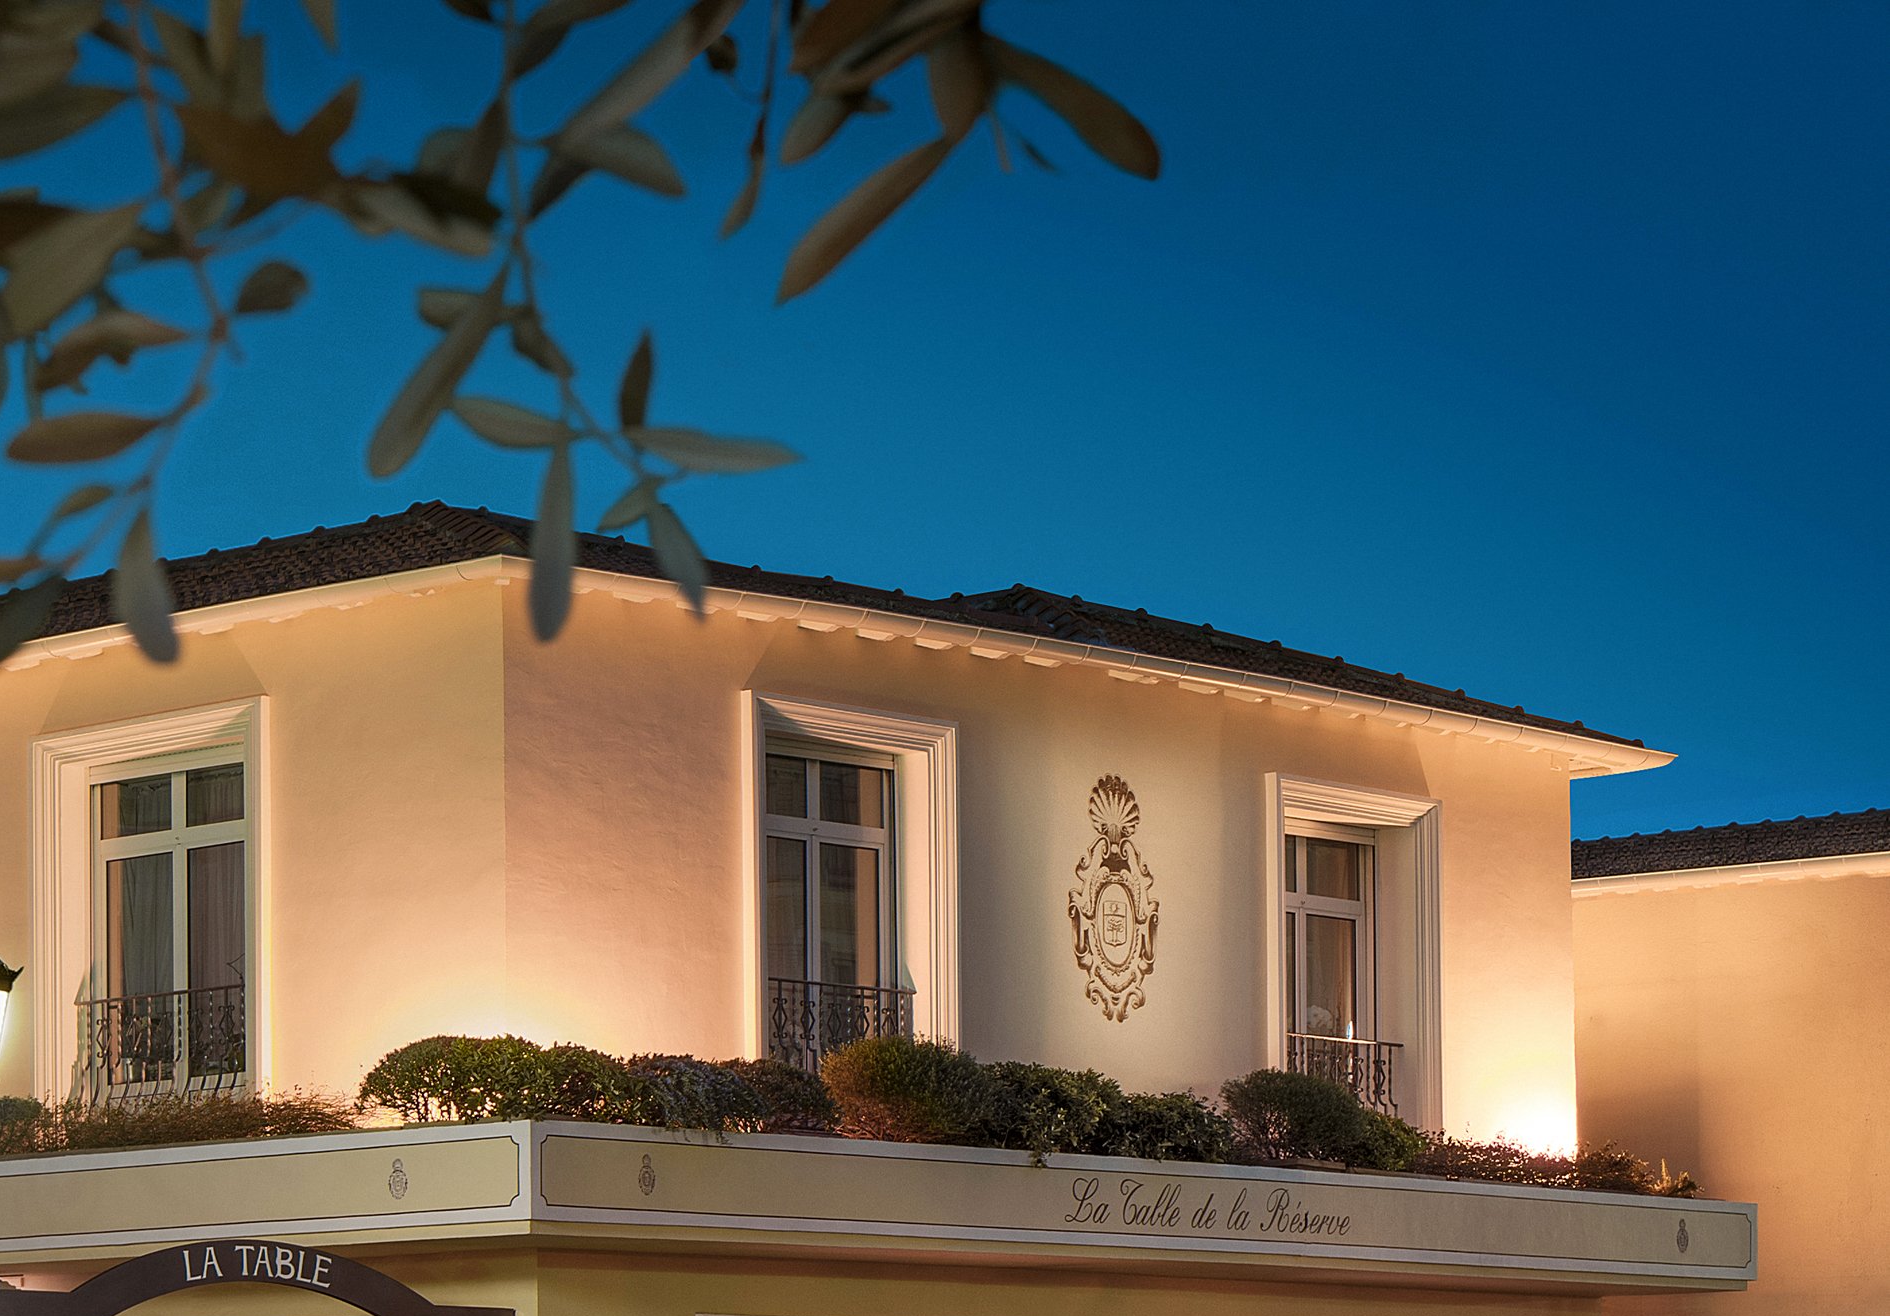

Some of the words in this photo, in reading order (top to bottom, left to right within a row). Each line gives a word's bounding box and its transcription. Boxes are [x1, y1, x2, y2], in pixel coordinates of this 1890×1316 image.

[1065, 1177, 1110, 1224] La
[1120, 1178, 1181, 1227] Table
[1191, 1193, 1217, 1229] de
[1226, 1188, 1251, 1231] la
[1260, 1187, 1350, 1235] Réserve
[183, 1246, 223, 1281] LA
[235, 1245, 332, 1288] TABLE
